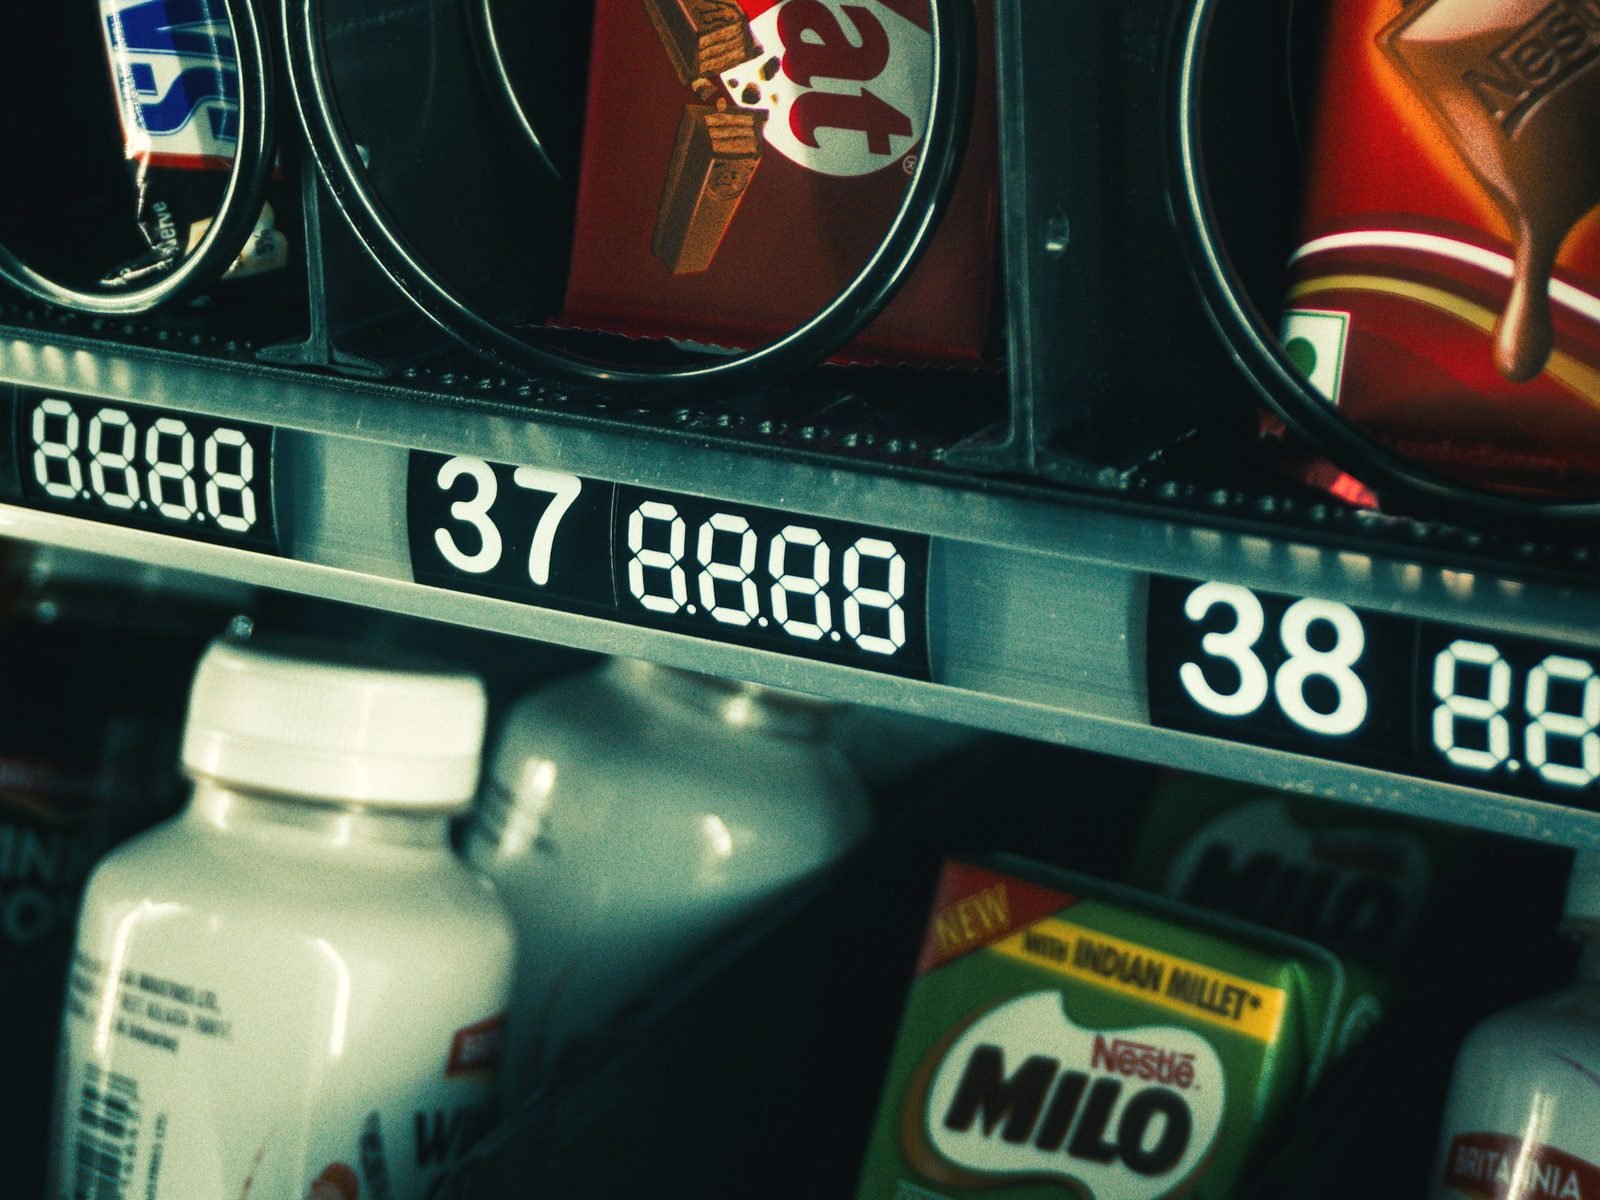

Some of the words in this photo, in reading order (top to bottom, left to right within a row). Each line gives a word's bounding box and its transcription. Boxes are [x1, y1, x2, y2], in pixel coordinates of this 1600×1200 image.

[432, 454, 583, 587] 37
[1177, 579, 1370, 737] 38
[932, 880, 1010, 950] NEW
[1074, 937, 1165, 993] INDIAN
[942, 1041, 1194, 1178] MILO
[1455, 1145, 1582, 1200] BRITANIA
